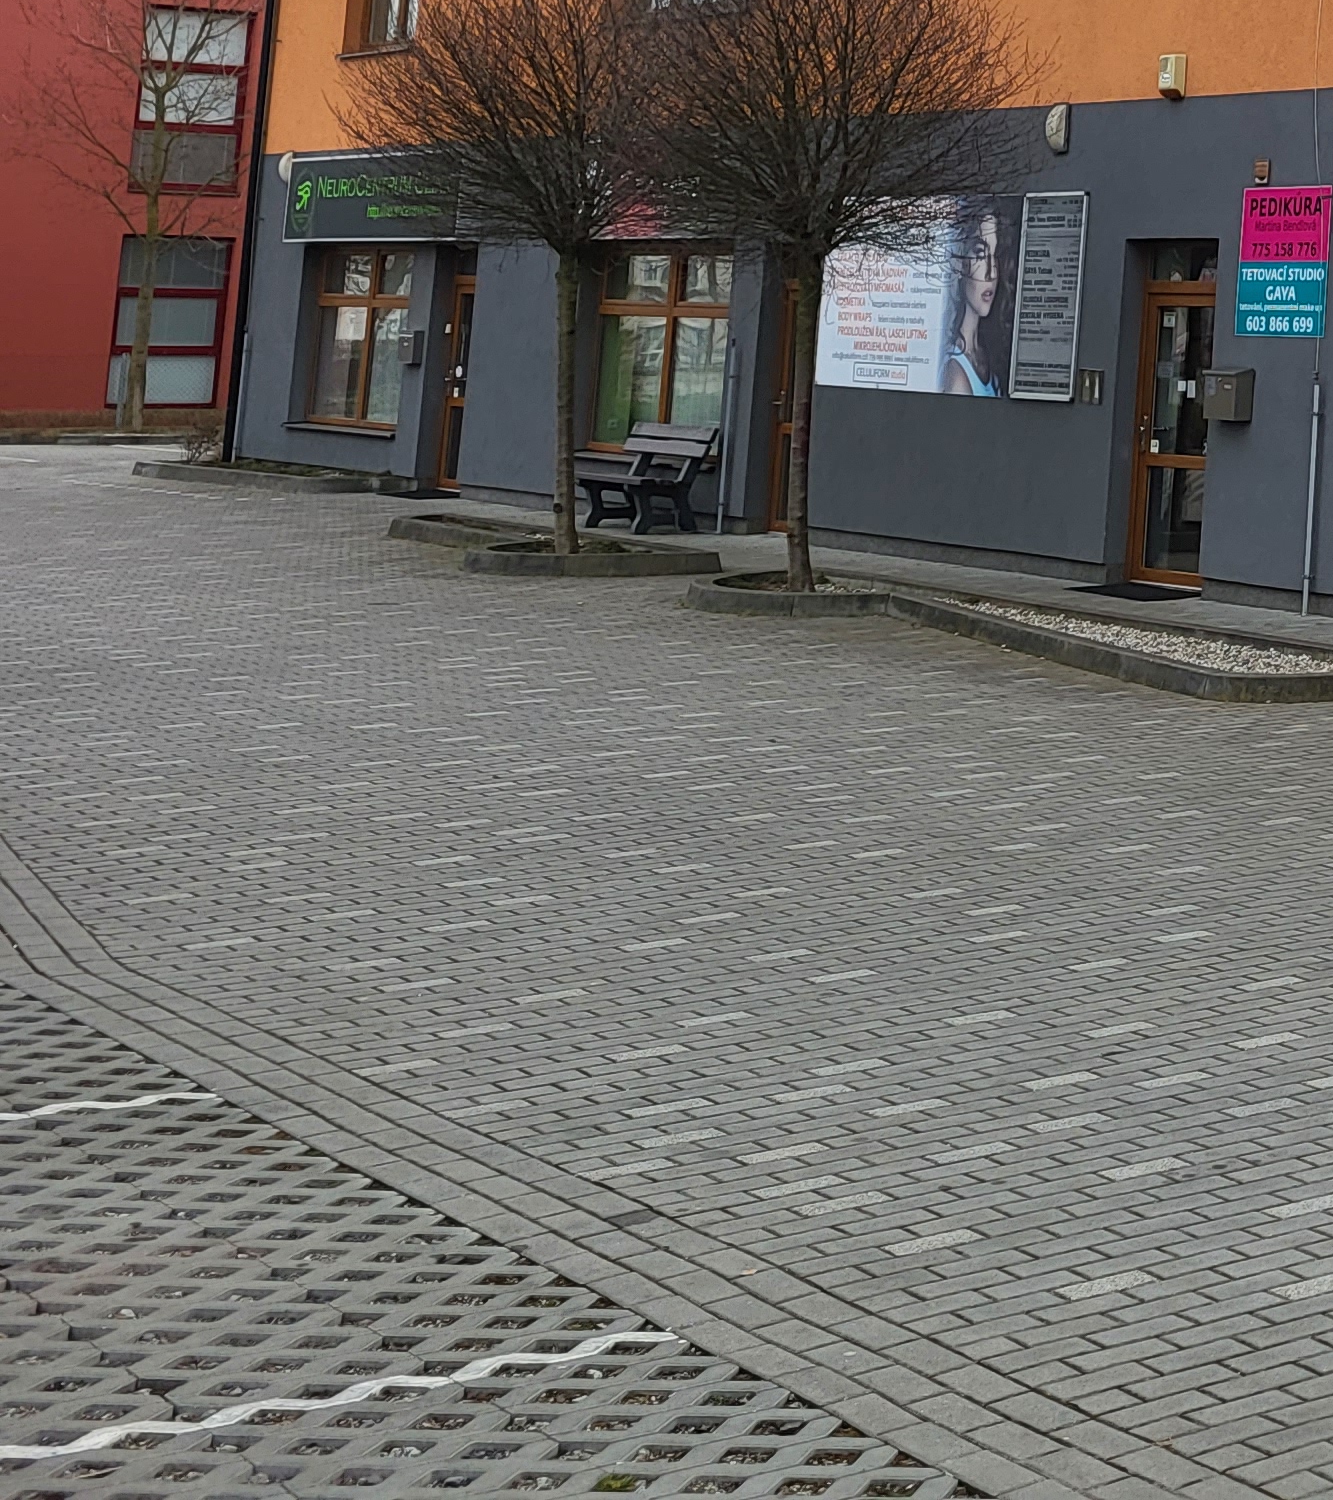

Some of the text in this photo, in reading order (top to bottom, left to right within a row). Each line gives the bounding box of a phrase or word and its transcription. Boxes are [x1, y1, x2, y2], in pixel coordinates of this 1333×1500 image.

[1249, 191, 1322, 218] PEDIKÚRA
[1251, 241, 1317, 257] 775 158 776
[1241, 265, 1324, 281] TETOVACÍ STUDIO
[1265, 285, 1296, 301] GAYA
[1245, 316, 1314, 333] 603 866 699
